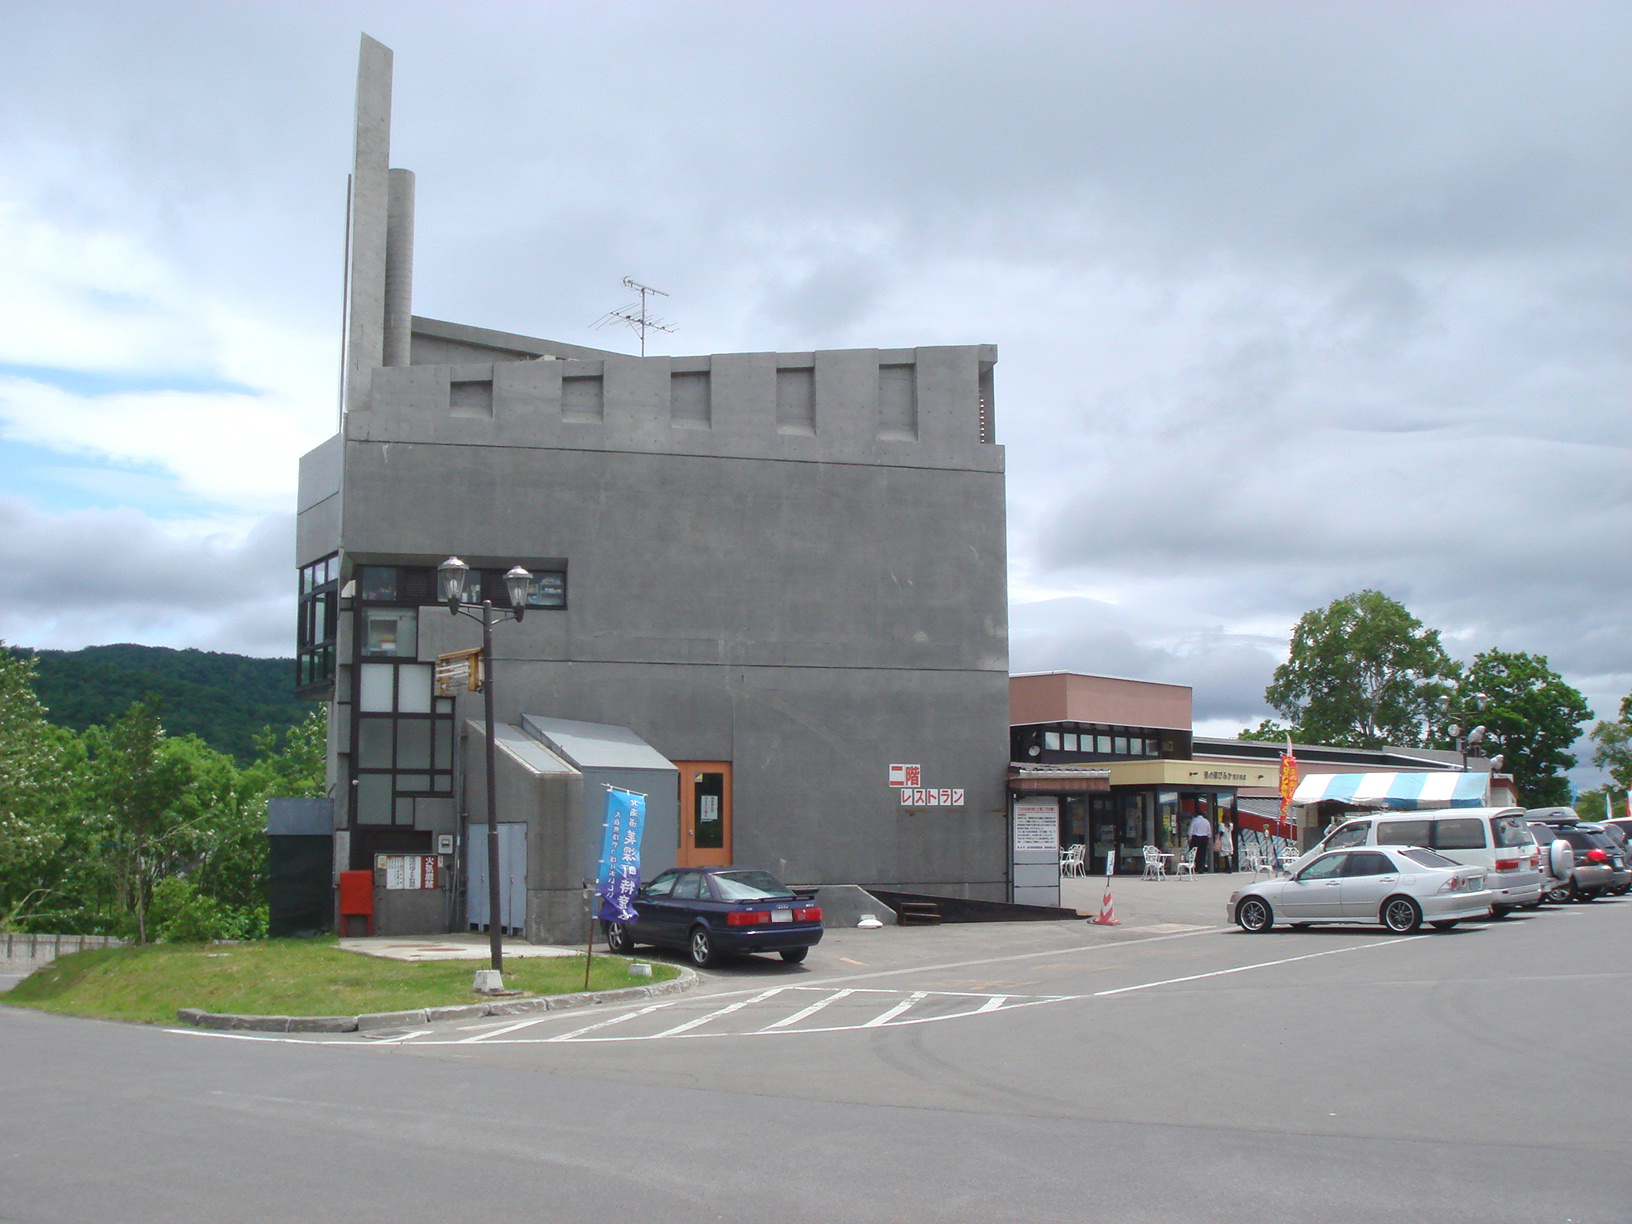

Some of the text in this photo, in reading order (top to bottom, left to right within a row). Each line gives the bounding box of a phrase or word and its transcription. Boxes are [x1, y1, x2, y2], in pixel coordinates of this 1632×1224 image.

[889, 766, 920, 786] 二階
[902, 789, 963, 804] レストラン
